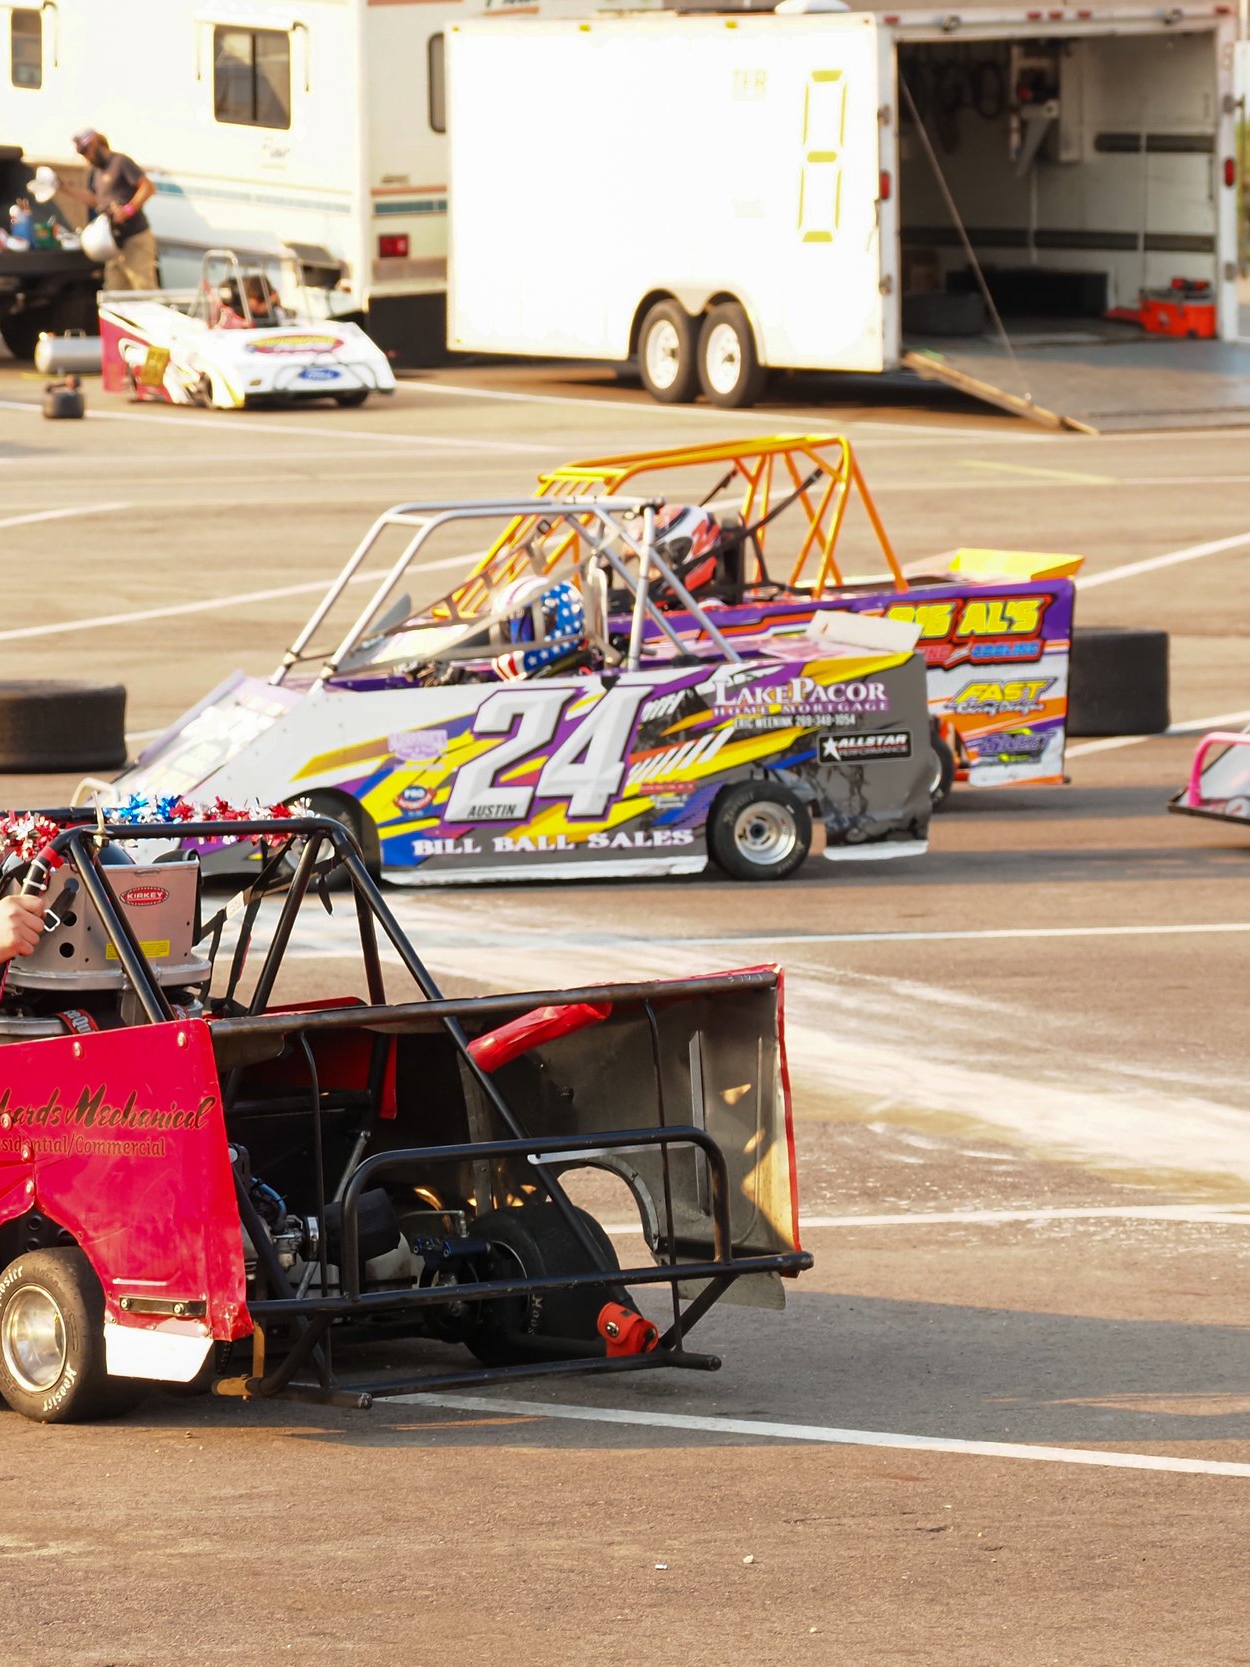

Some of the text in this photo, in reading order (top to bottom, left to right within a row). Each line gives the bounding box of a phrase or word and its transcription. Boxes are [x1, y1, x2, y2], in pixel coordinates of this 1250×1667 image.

[956, 598, 1045, 635] AL'S
[954, 681, 1048, 704] FAST
[713, 700, 890, 717] HOME MORTGAGE
[837, 733, 908, 748] ALLSTAR
[443, 685, 655, 822] 24
[466, 803, 517, 818] AUSTIN
[411, 828, 695, 856] BILL BALL SALES
[126, 891, 164, 901] KIRKEY
[65, 1083, 216, 1130] Mechanical
